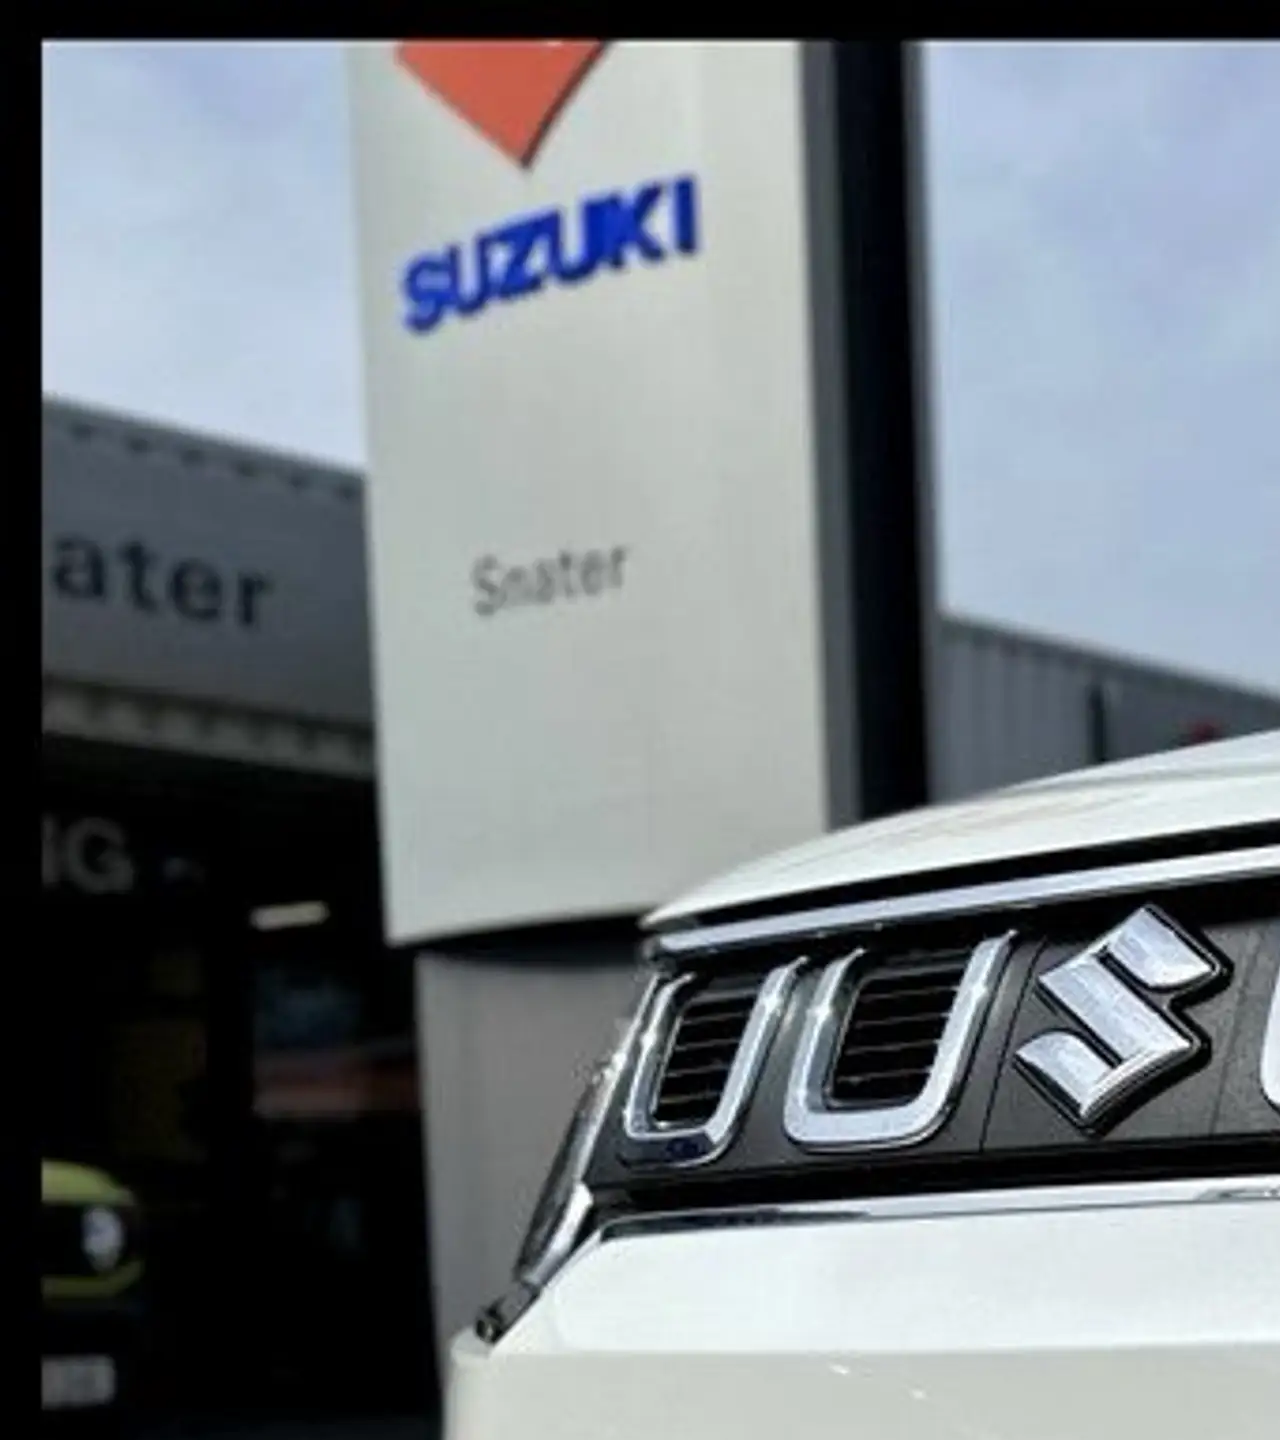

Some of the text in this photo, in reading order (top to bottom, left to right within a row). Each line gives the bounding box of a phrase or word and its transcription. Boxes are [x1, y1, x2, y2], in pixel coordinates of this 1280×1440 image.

[401, 175, 702, 336] SUZUKI
[52, 533, 275, 627] ater
[472, 542, 630, 617] Snater
